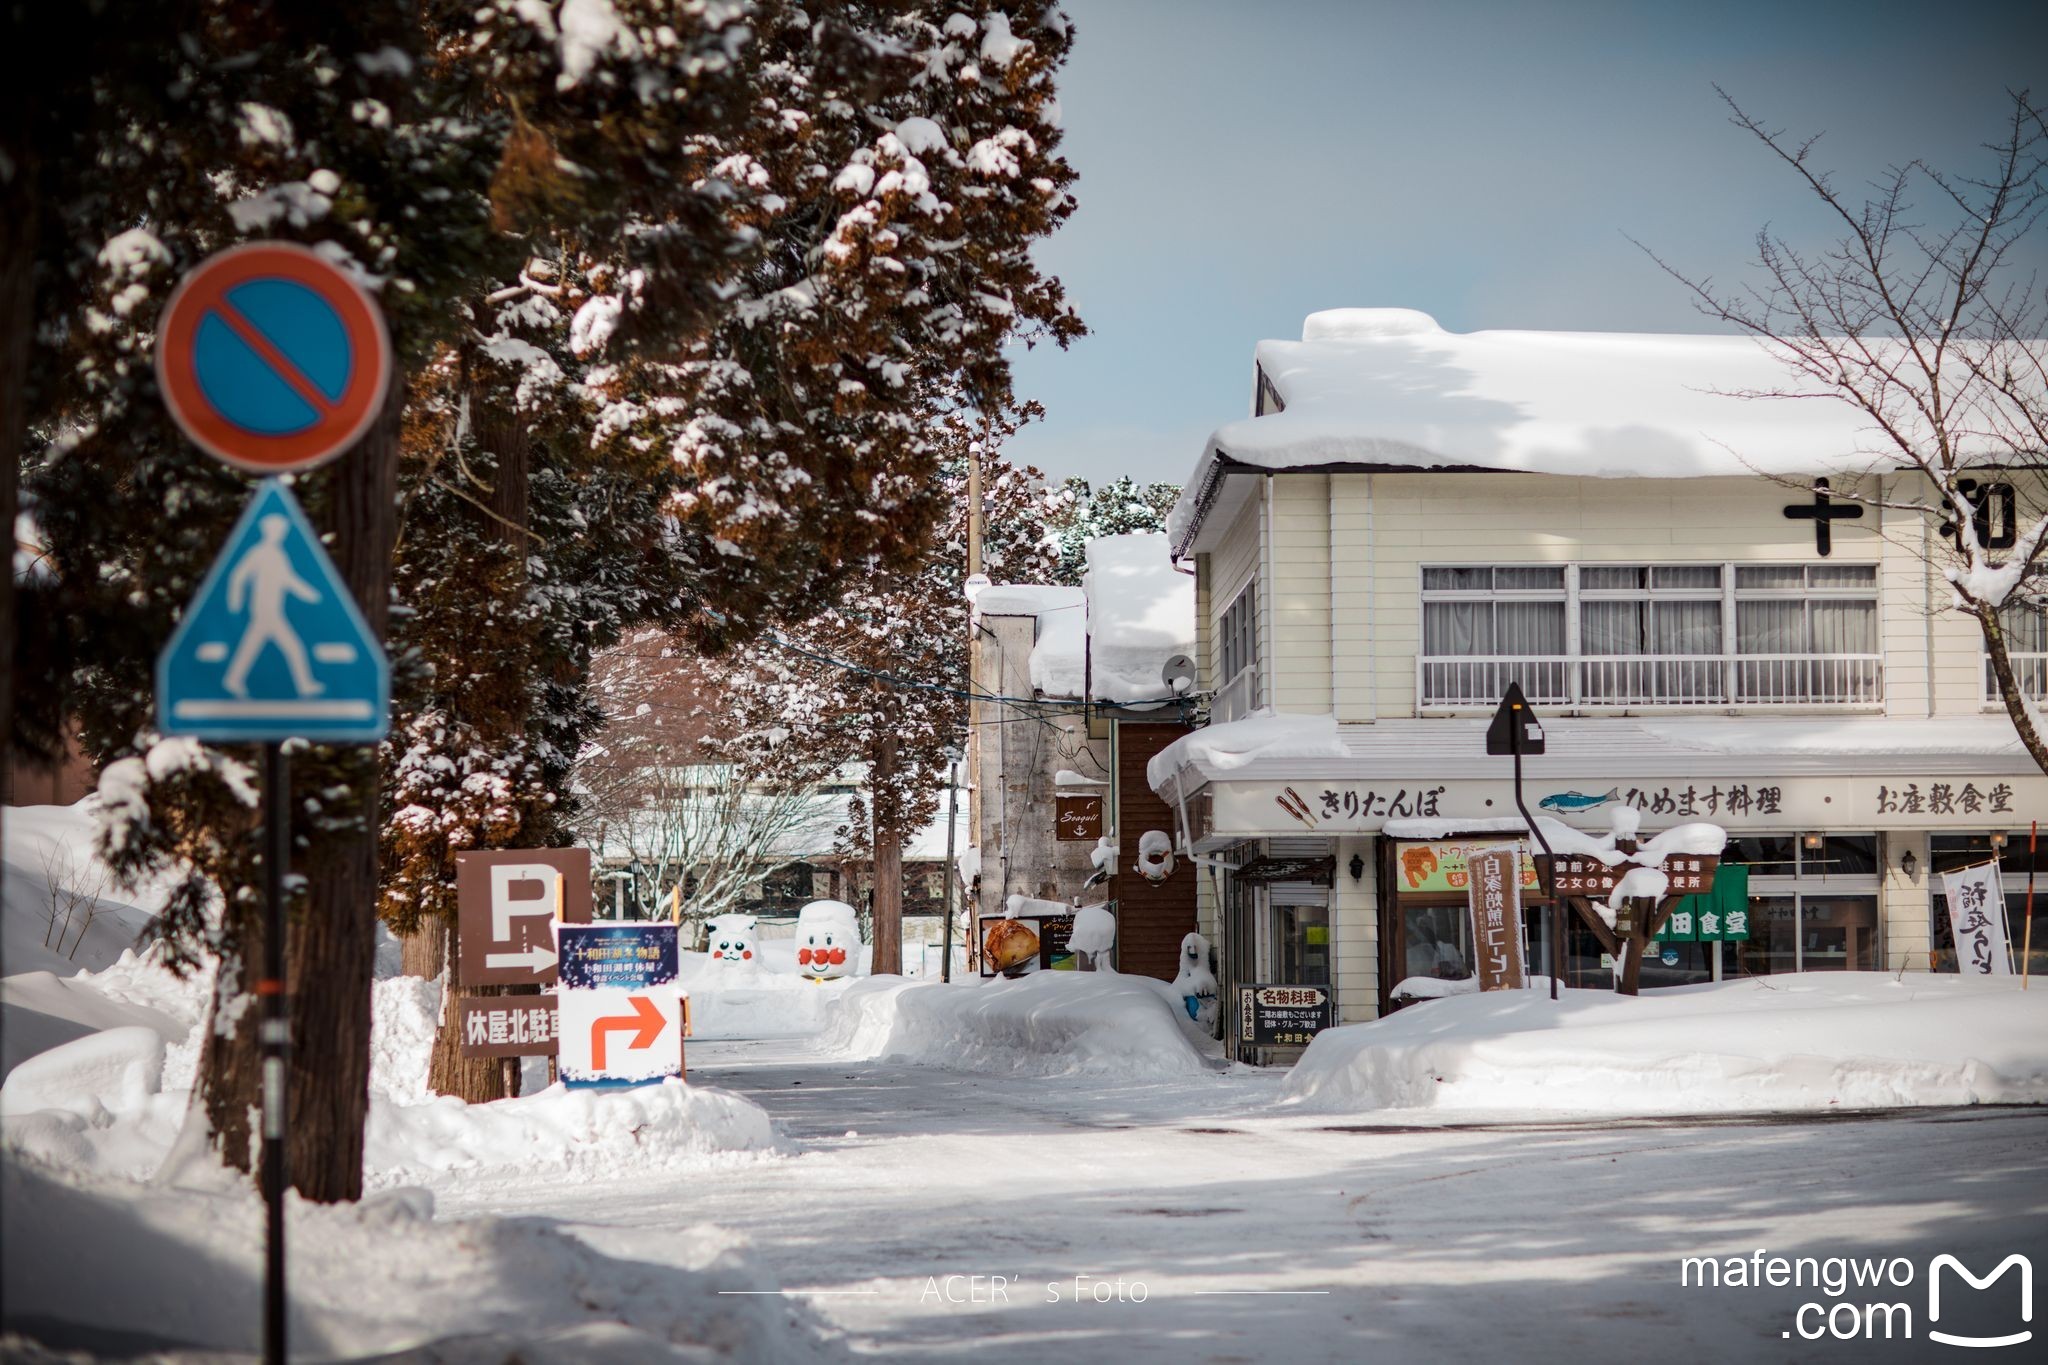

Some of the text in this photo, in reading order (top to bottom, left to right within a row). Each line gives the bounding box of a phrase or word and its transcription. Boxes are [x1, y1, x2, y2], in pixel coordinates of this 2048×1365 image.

[1319, 783, 2013, 819] きりたんぽ ひめます料理 お座敷食堂
[1060, 811, 1098, 823] Seagull
[1555, 876, 1614, 889] 乙女の像
[490, 863, 560, 942] P
[1263, 990, 1317, 1005] 名物料理
